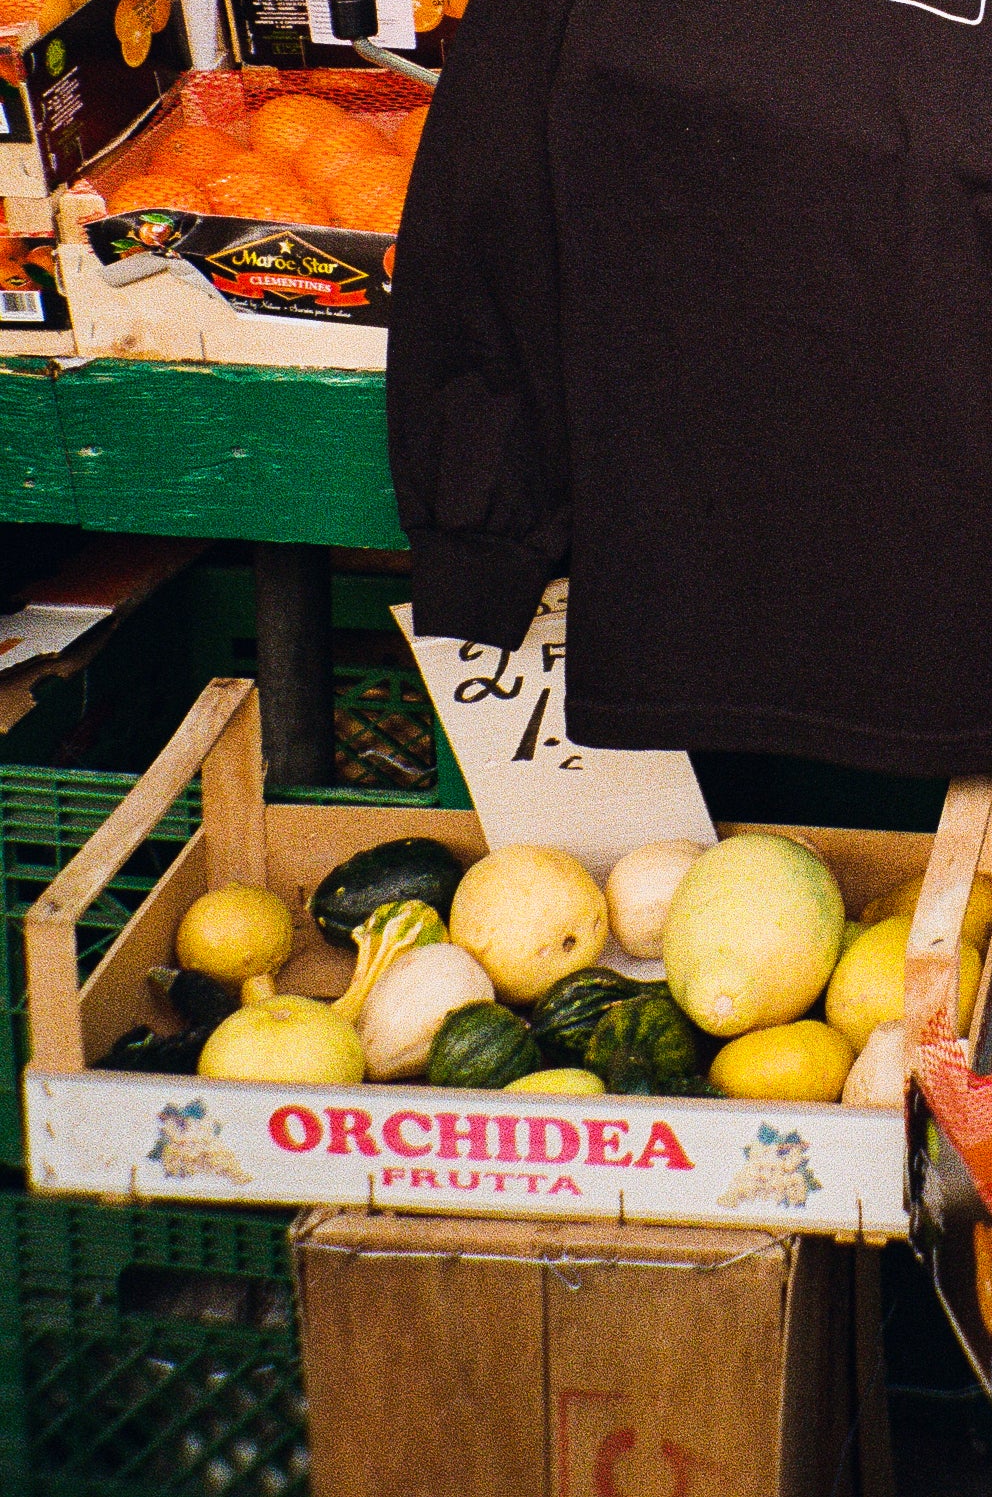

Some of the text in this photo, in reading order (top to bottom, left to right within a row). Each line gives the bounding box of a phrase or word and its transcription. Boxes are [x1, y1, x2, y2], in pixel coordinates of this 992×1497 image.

[232, 250, 339, 276] Maroc Star
[268, 1104, 696, 1170] ORCHIDEA
[381, 1166, 583, 1196] FRUTTA
